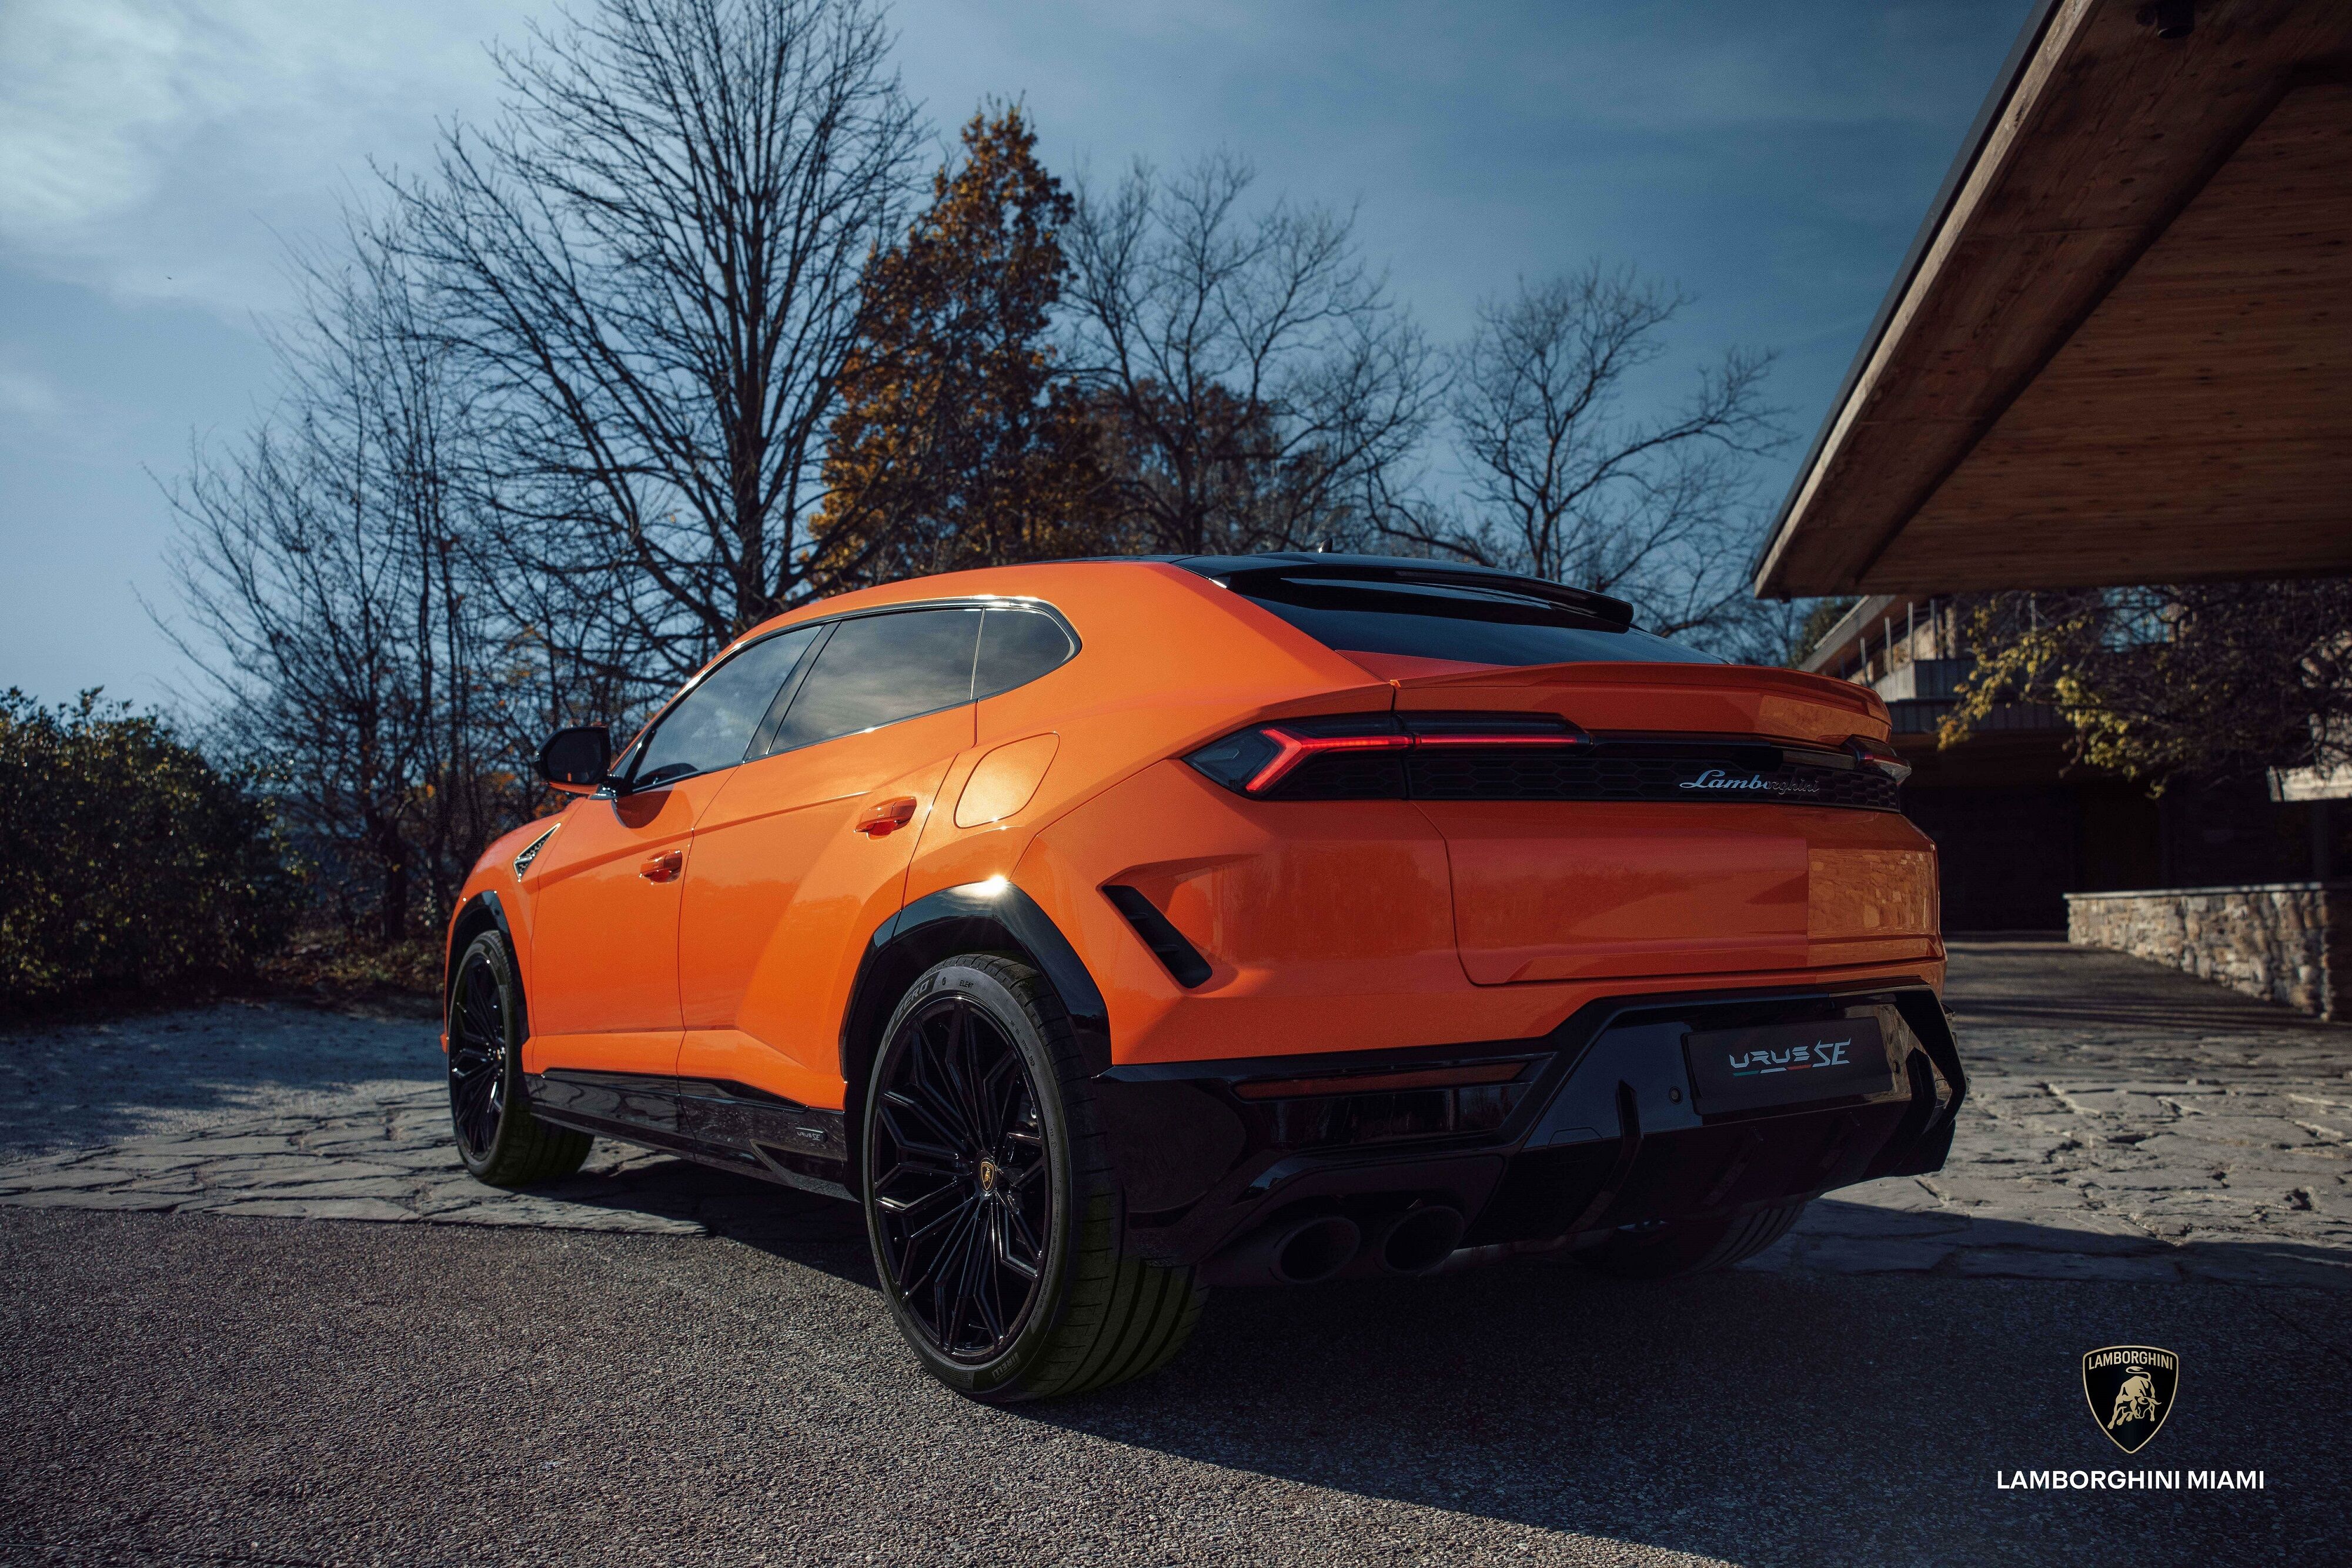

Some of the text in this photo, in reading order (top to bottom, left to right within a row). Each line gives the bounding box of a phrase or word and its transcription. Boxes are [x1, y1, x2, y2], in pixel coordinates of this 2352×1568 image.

[1679, 769, 1820, 794] Lamborghini
[1729, 1038, 1851, 1068] URUS SE
